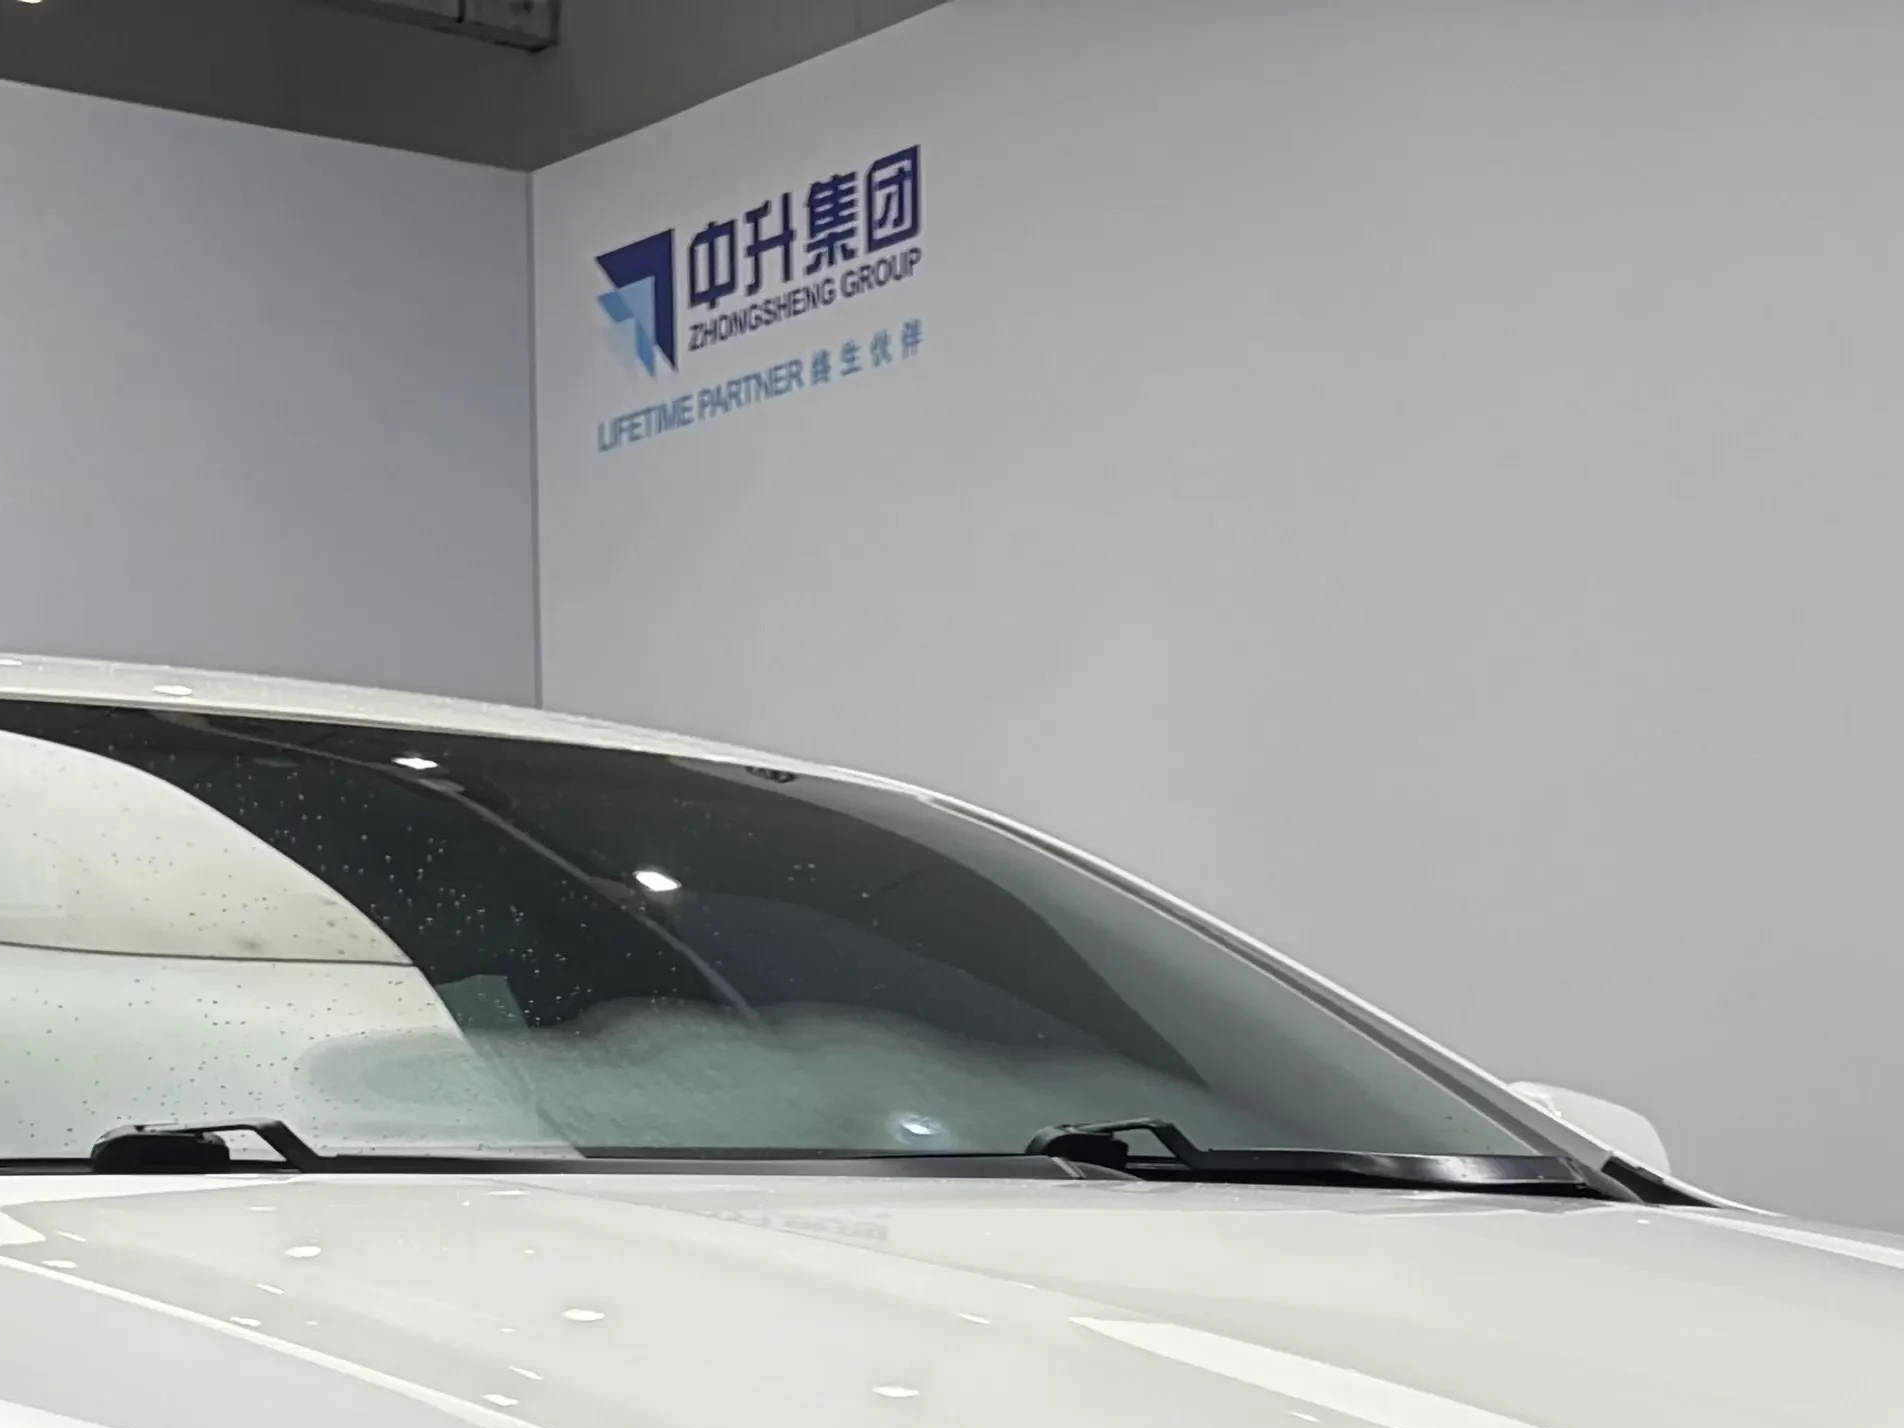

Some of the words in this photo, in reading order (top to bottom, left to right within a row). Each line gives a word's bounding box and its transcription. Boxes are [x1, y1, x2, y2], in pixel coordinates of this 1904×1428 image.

[687, 144, 921, 310] 中升集团
[688, 278, 836, 351] ZHONGSHENG
[840, 247, 922, 299] GROUP
[598, 395, 694, 452] LIFETIME
[698, 359, 804, 420] PARTNER
